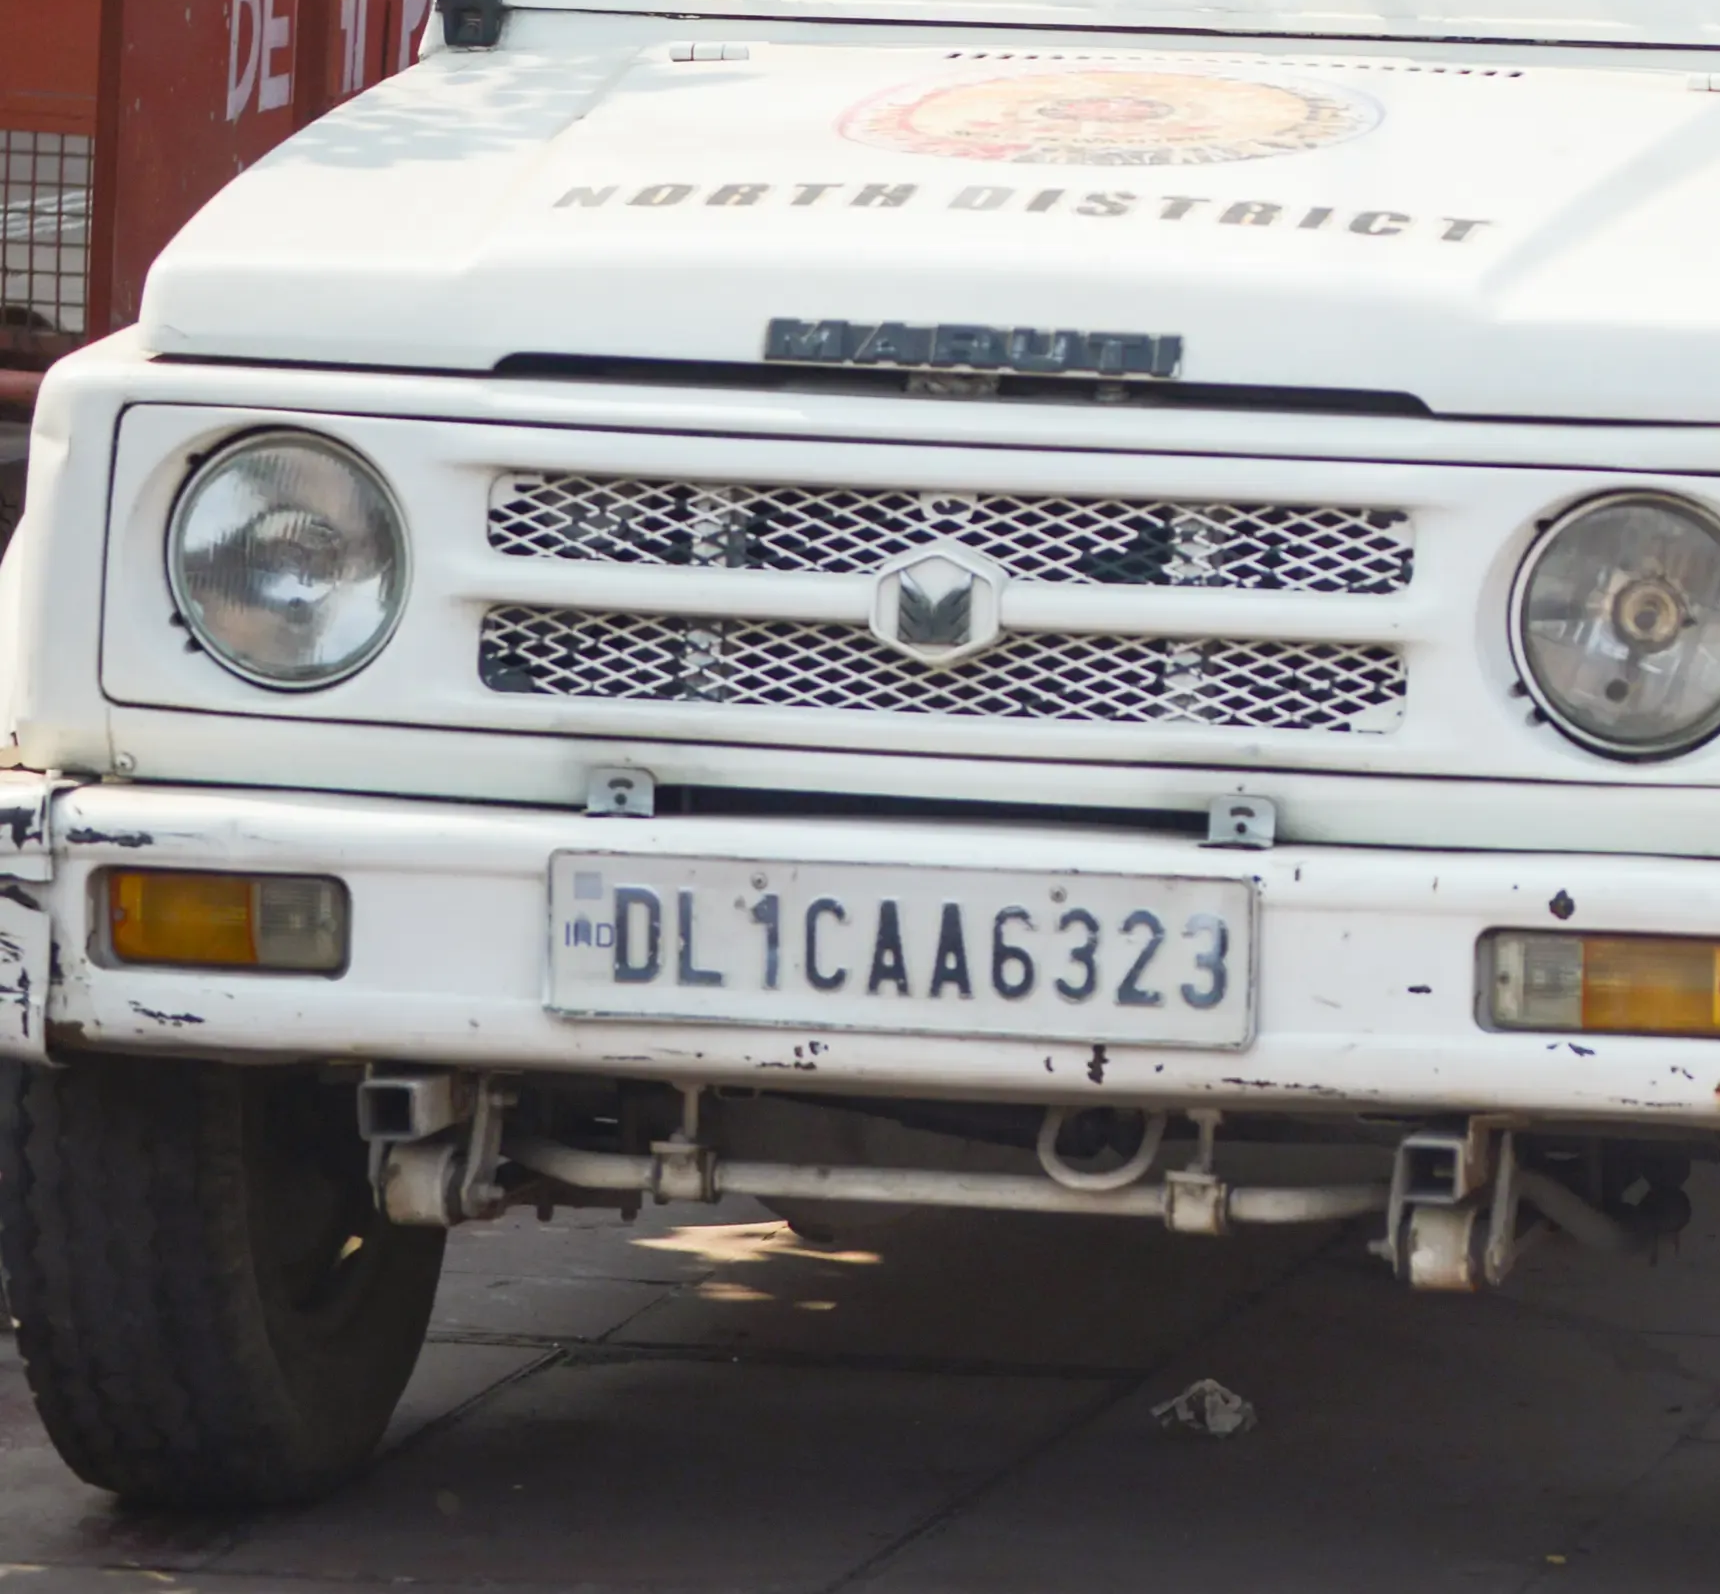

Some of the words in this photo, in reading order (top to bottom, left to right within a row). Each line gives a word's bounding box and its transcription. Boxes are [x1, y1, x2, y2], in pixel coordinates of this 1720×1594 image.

[553, 183, 918, 208] NORTH
[947, 184, 1491, 243] DISTRICT
[764, 317, 1183, 380] MARUTI
[613, 886, 1230, 1010] DL1CAA6323
